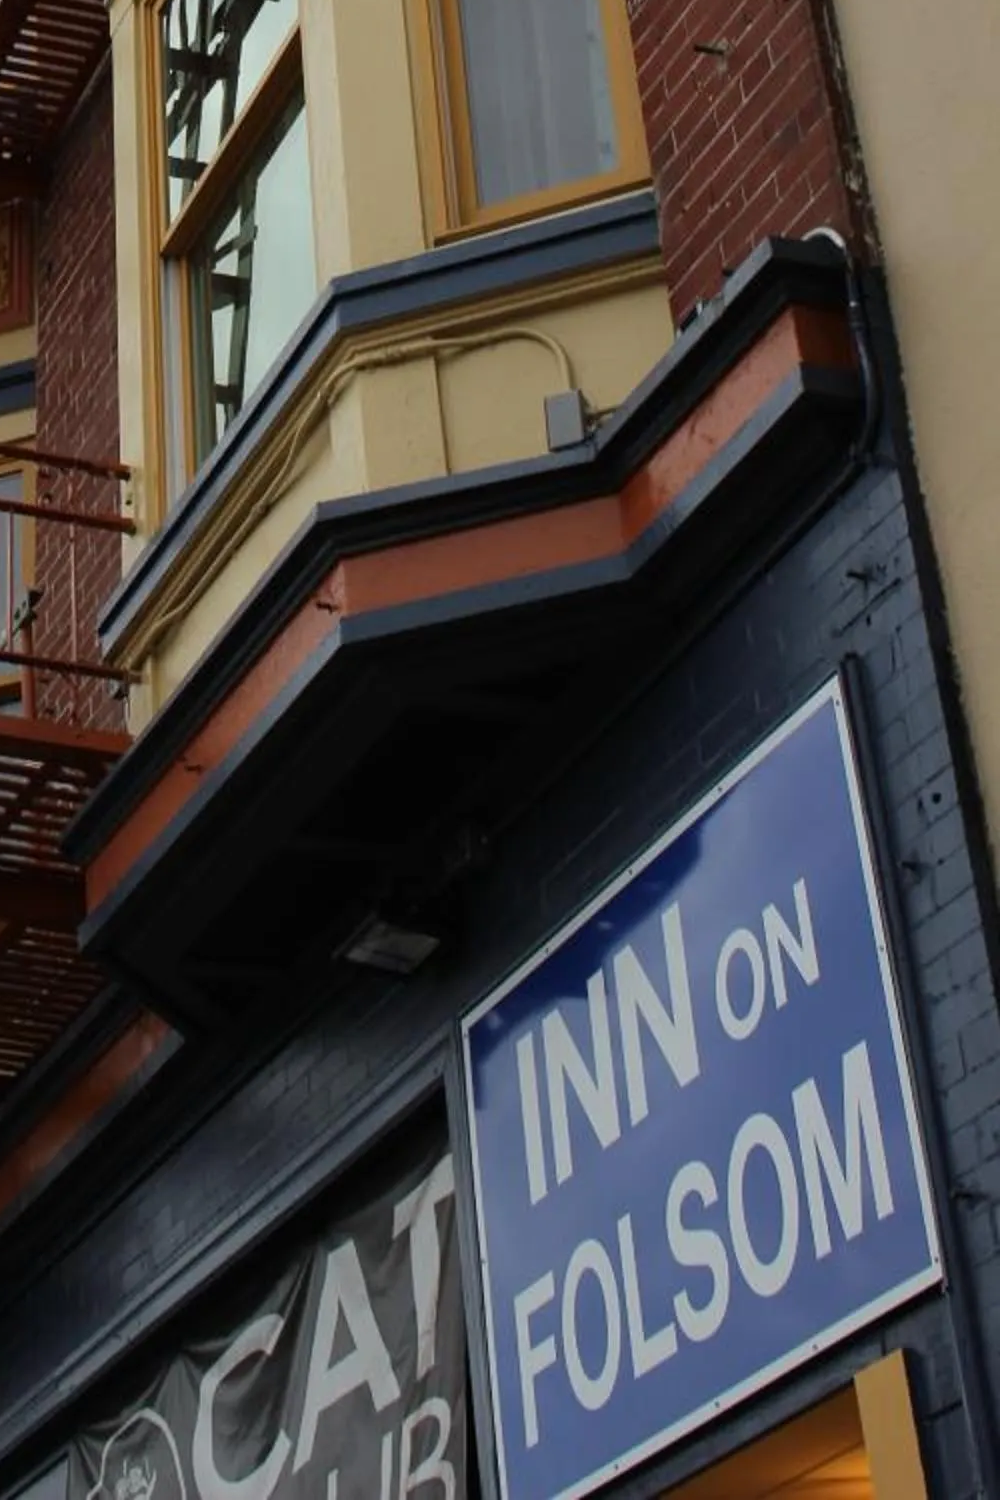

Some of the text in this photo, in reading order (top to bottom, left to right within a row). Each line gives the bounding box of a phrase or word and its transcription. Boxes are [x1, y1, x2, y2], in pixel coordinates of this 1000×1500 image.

[515, 878, 821, 1206] INN ON
[192, 1153, 456, 1498] CAT
[514, 1040, 896, 1449] FOLSOM
